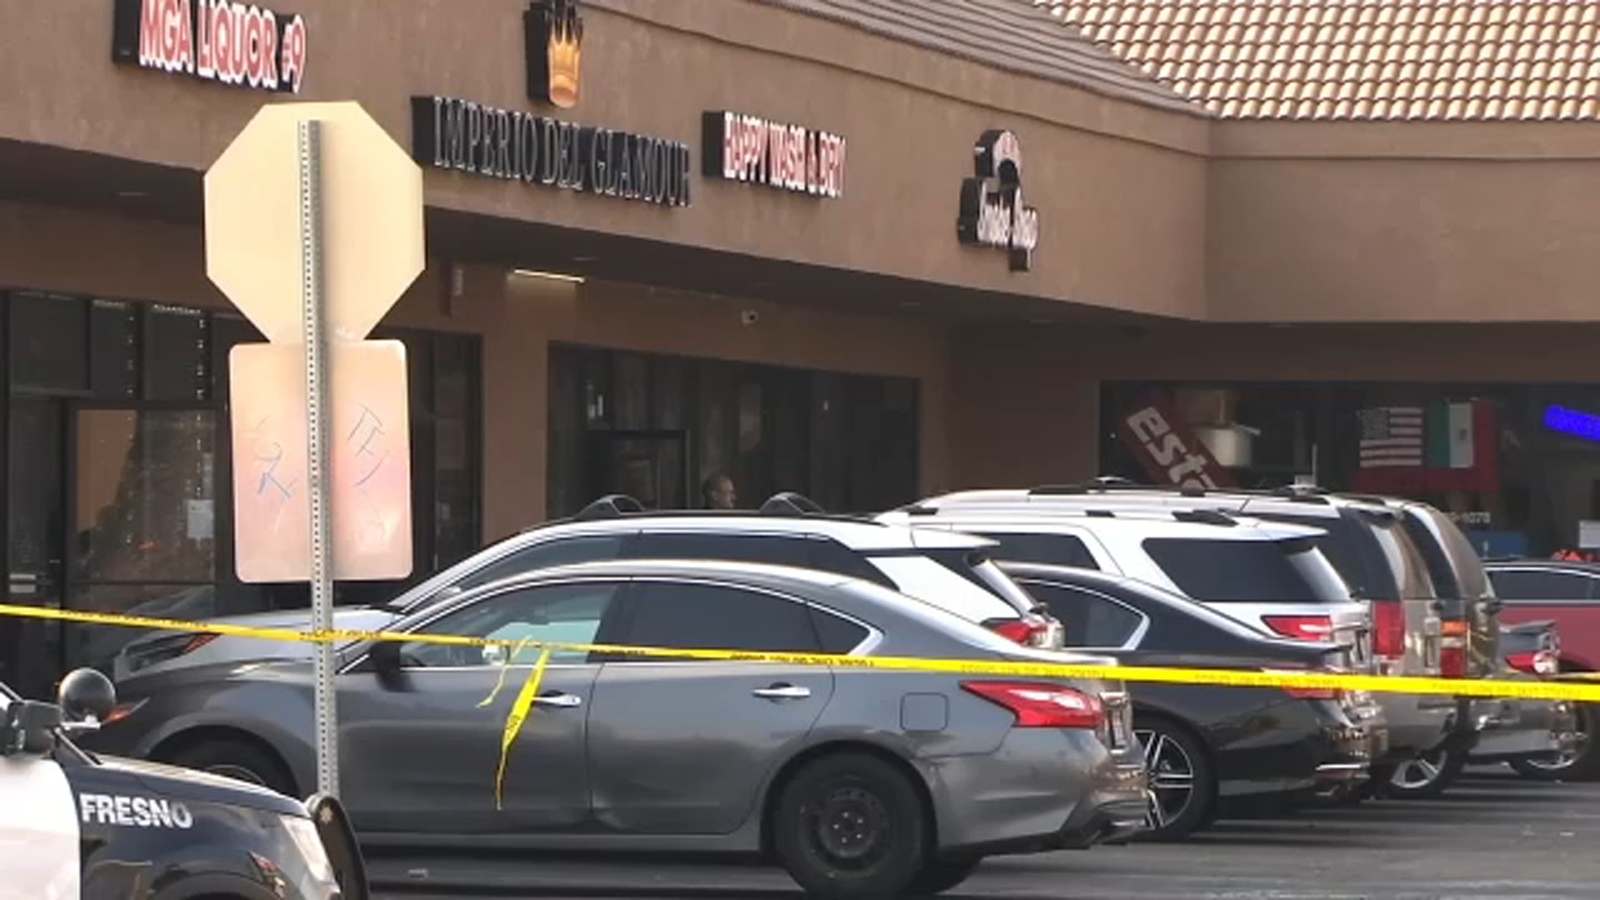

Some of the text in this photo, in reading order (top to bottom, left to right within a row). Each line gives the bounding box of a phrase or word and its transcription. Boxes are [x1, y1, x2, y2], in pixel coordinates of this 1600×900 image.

[139, 0, 306, 93] MGA LIQUOR #9
[433, 95, 692, 207] IMPERIO DEL GLAMOUR
[723, 111, 768, 183] HAPPY
[769, 120, 806, 191] WASH
[819, 131, 847, 198] DRY
[80, 792, 193, 829] FRESNO
